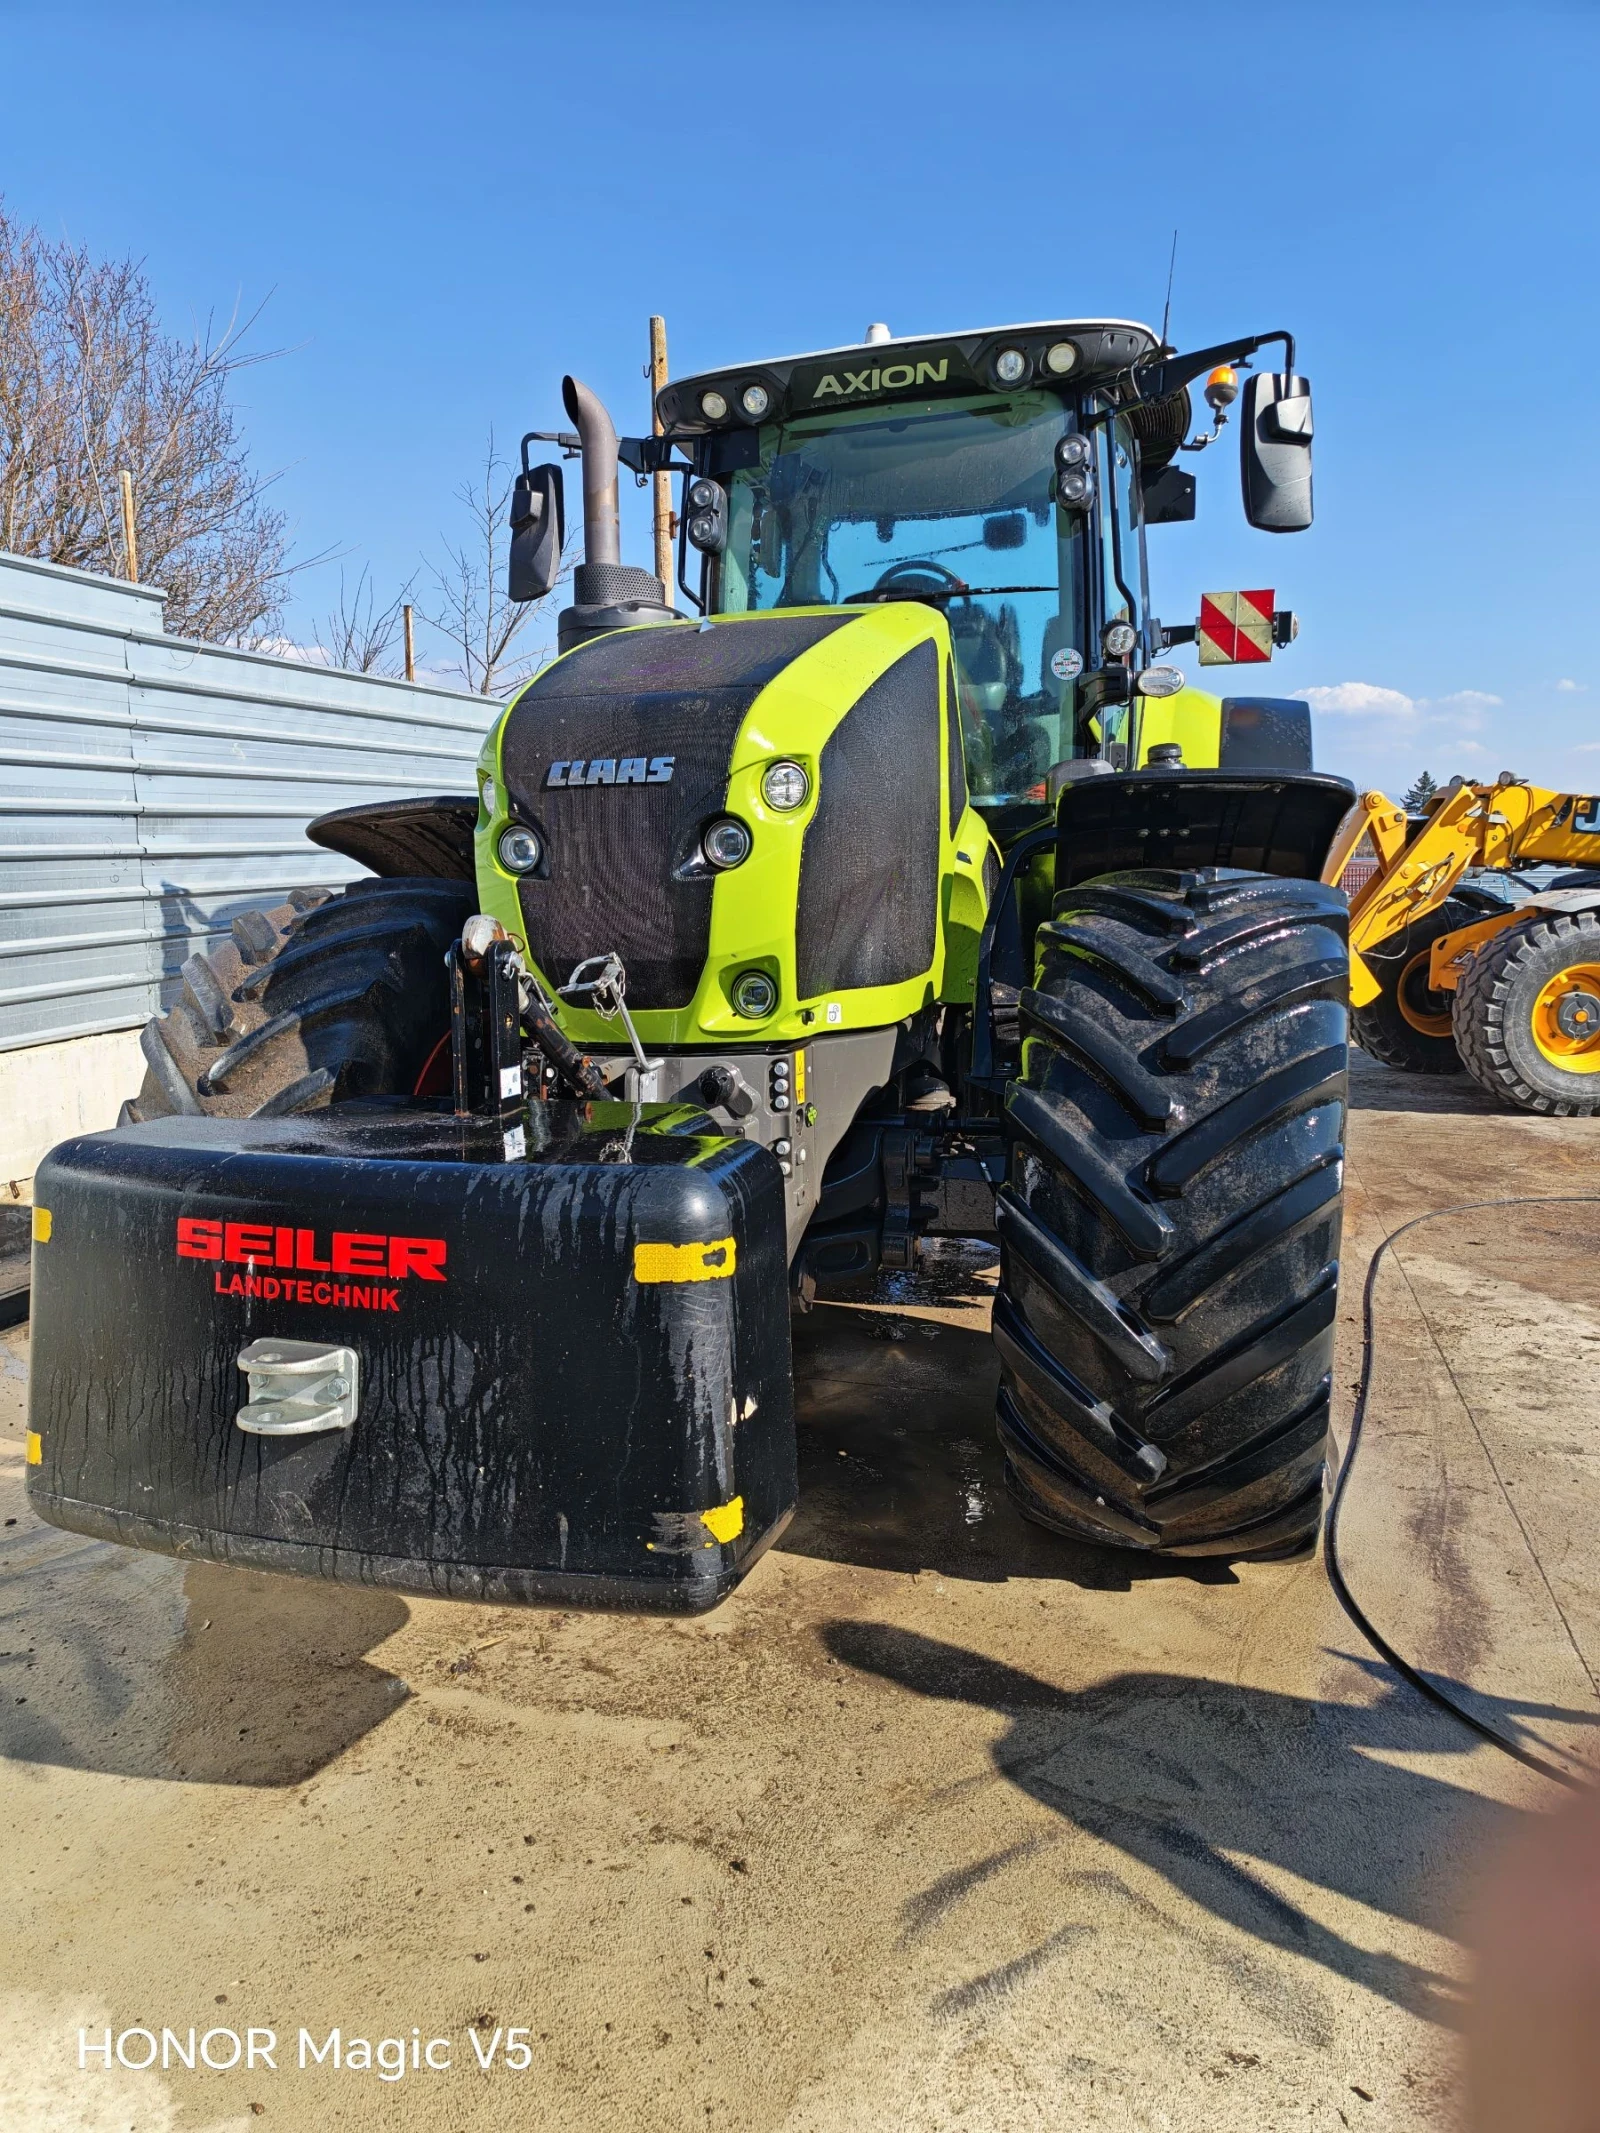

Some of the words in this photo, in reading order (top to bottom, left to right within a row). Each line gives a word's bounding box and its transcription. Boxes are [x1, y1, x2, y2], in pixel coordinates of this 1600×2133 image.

[813, 358, 949, 397] AXION
[546, 756, 675, 787] CLAAS
[176, 1217, 448, 1282] SEILER
[214, 1270, 400, 1312] LANDTECHNIK
